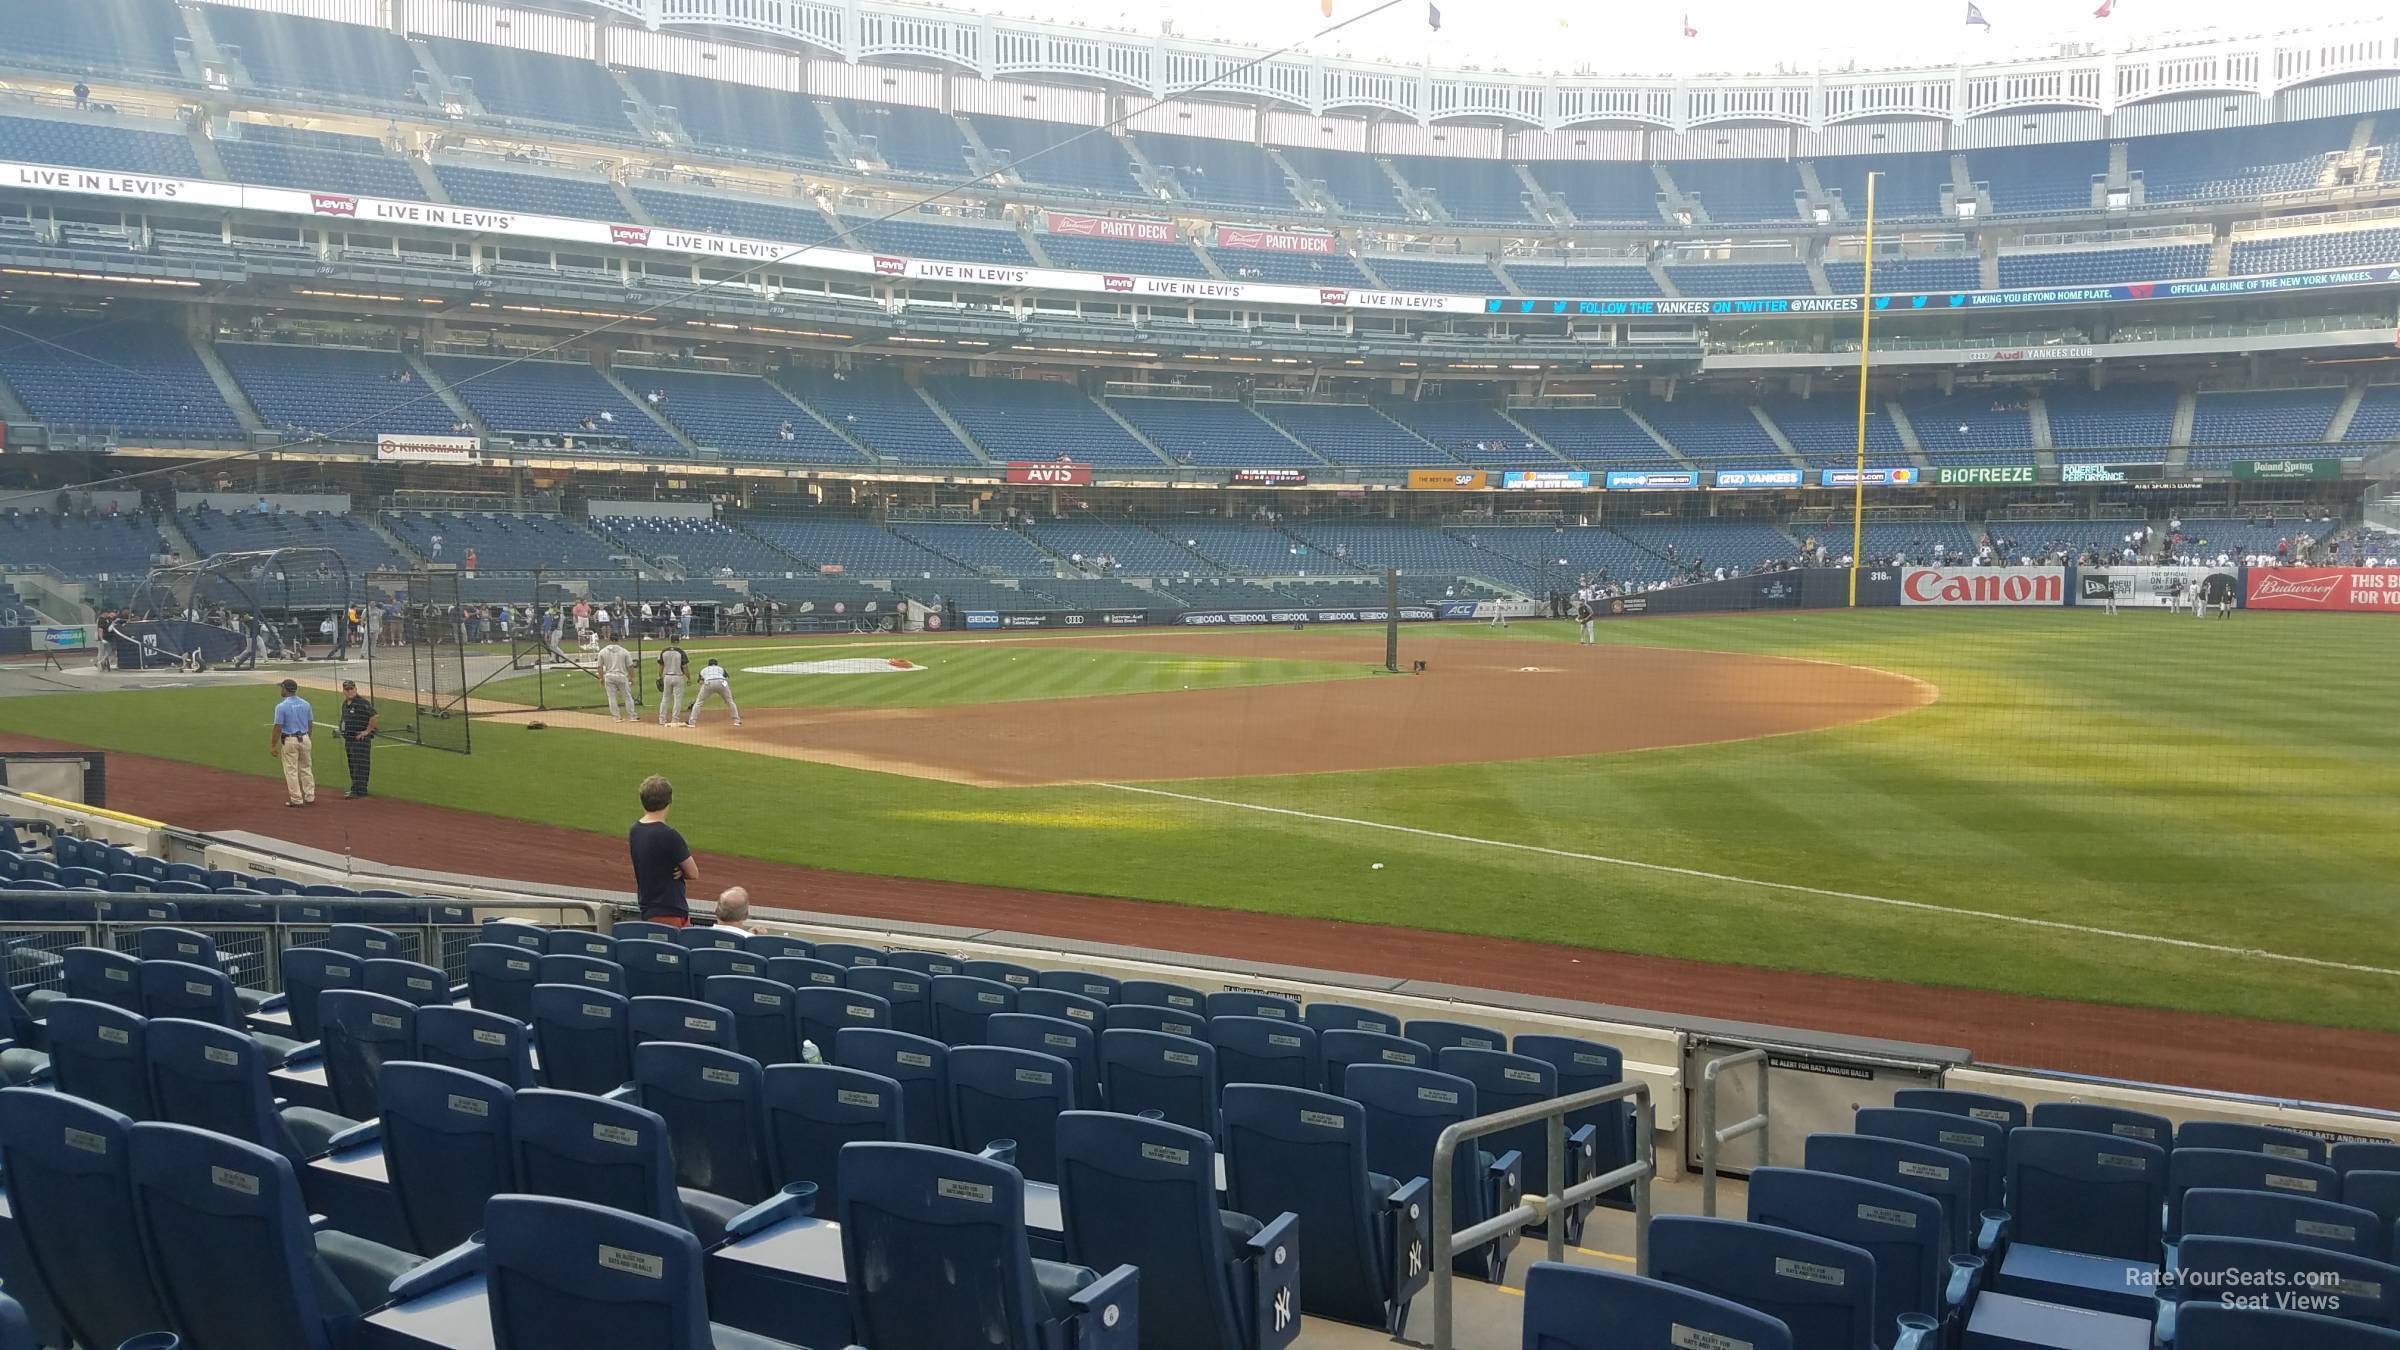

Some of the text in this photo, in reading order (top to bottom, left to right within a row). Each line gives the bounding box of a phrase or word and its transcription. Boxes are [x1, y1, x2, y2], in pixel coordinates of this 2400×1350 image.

[21, 170, 69, 187] LIVE
[78, 175, 99, 189] IN
[377, 204, 419, 220] LIVE
[427, 210, 445, 223] IN
[1101, 221, 1135, 238] PARTY
[1138, 223, 1167, 239] DECK
[666, 235, 702, 249] LIVE
[708, 239, 723, 252] IN
[1266, 235, 1298, 250] PARTY
[1300, 237, 1328, 251] DECK
[921, 264, 953, 277] LIVE
[959, 267, 973, 279] IN
[1148, 280, 1177, 293] LIVE
[1182, 283, 1195, 295] IN
[2170, 271, 2373, 294] OFFICIAL AIRLINE OF THE NEW YORK YANKEES.
[1360, 295, 1386, 305] LIVE
[1390, 296, 1404, 307] IN
[1972, 289, 2112, 304] TAKING YOU BEYOND HOME PLATE.
[1579, 298, 1858, 314] FOLLOW THE YANKEES ON TWITTER @YANKEES
[1994, 347, 2093, 360] Audi YANKEES CLUB
[400, 443, 464, 454] KIKKOMAN
[1027, 464, 1072, 481] AVIS
[2063, 464, 2107, 473] POWERFUL
[2254, 461, 2313, 473] Poland Spring
[1456, 475, 1472, 485] SAP
[1719, 472, 1798, 484] (212) YANKEES
[1904, 570, 2061, 602] Canon
[2112, 580, 2132, 588] NEW
[2150, 577, 2188, 585] ON-FIELD
[2260, 580, 2331, 594] Budweiser
[2351, 574, 2384, 588] THIS
[2350, 591, 2378, 604] FOR
[1416, 611, 1434, 619] COOL
[1448, 605, 1472, 614] ACC
[967, 615, 999, 623] GEICO
[1203, 615, 1226, 623] COOL
[1246, 614, 1268, 622] COOL
[1288, 613, 1310, 621] COOL
[1779, 1060, 1797, 1068] ALERT
[1798, 1062, 1810, 1070] FOR
[1810, 1064, 1826, 1073] BATS
[1850, 1069, 1869, 1078] BALLS
